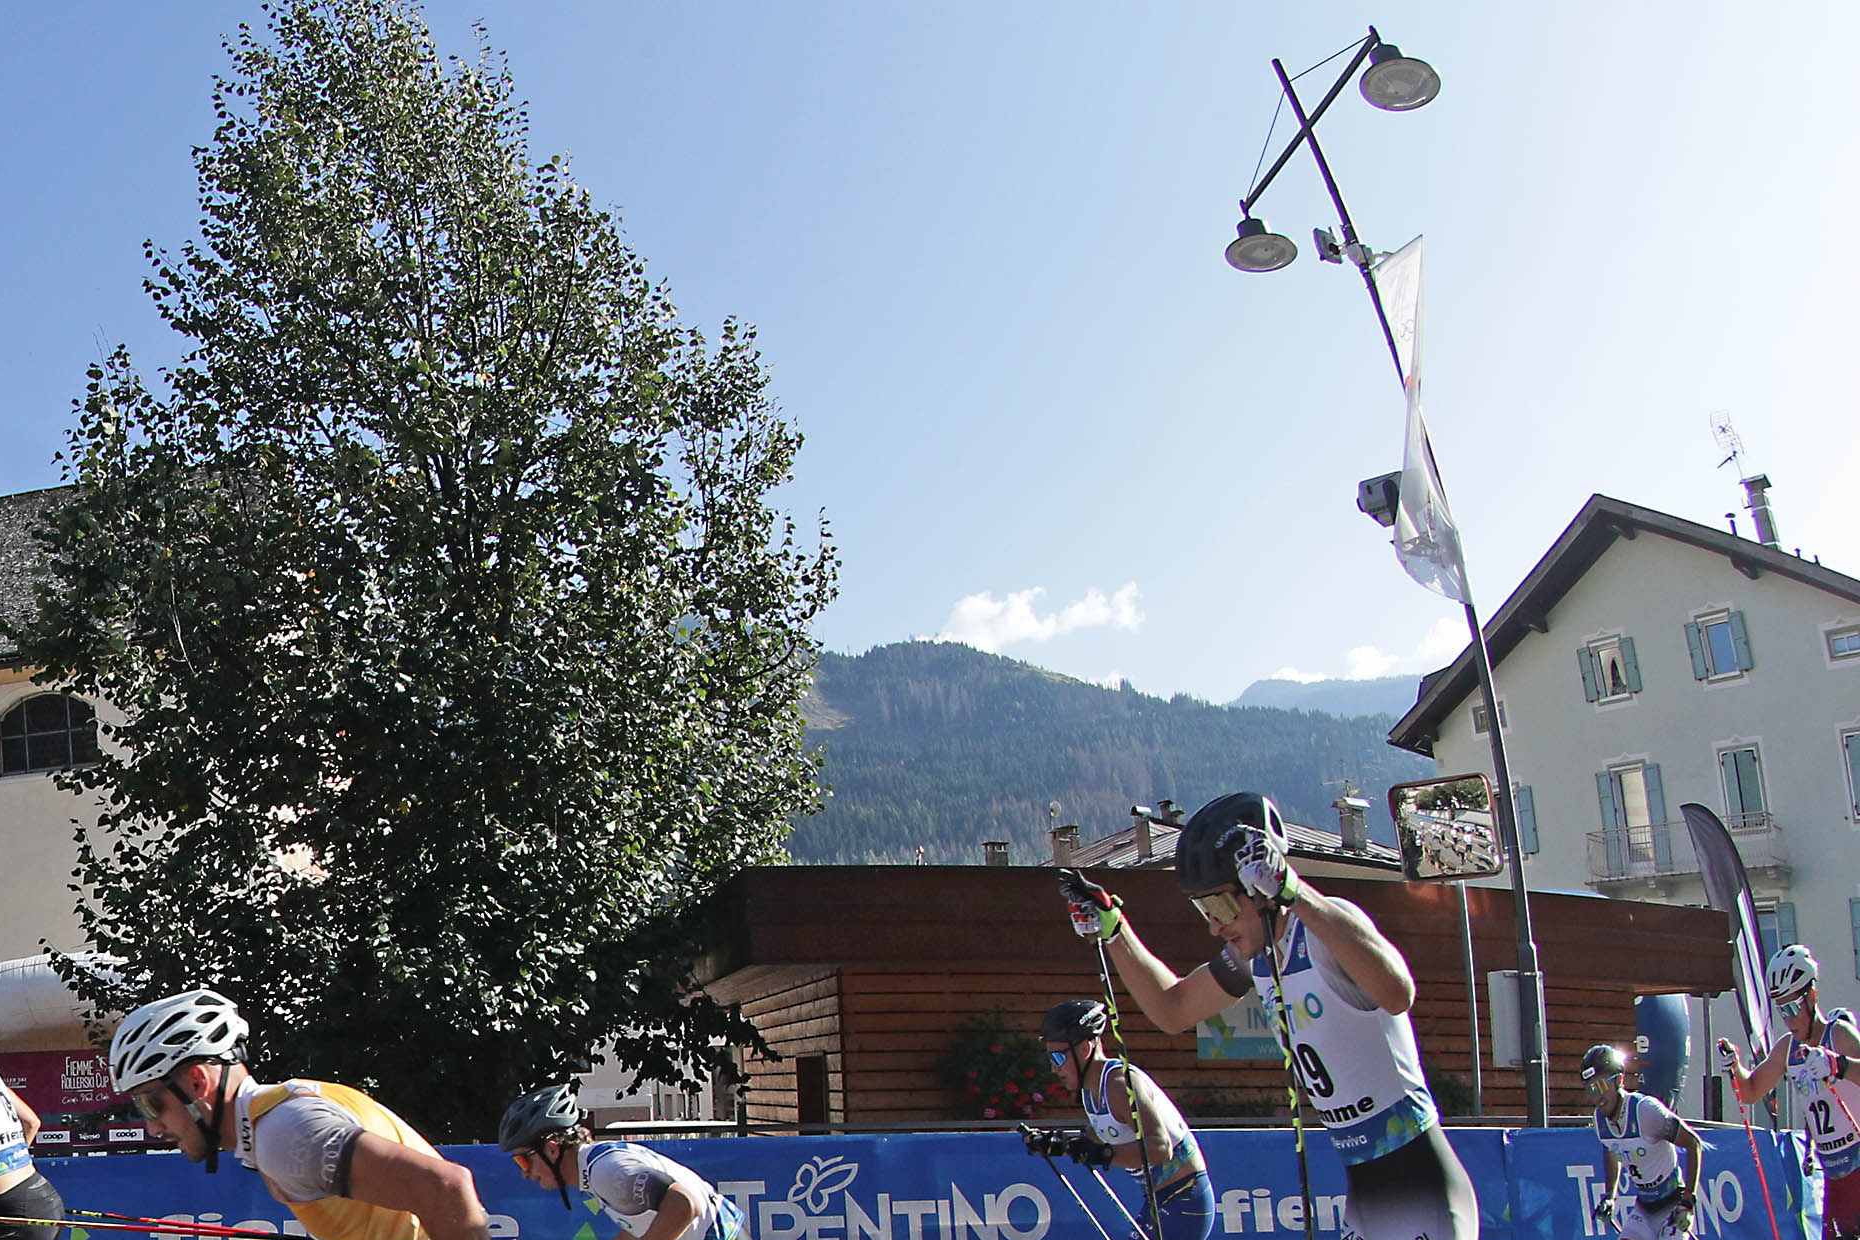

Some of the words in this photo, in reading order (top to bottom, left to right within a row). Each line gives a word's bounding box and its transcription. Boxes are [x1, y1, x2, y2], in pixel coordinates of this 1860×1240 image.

[66, 1056, 94, 1076] FIEMME
[1317, 1096, 1375, 1123] mme
[1809, 1099, 1836, 1135] 12
[42, 1132, 64, 1141] coop
[115, 1130, 137, 1139] coop
